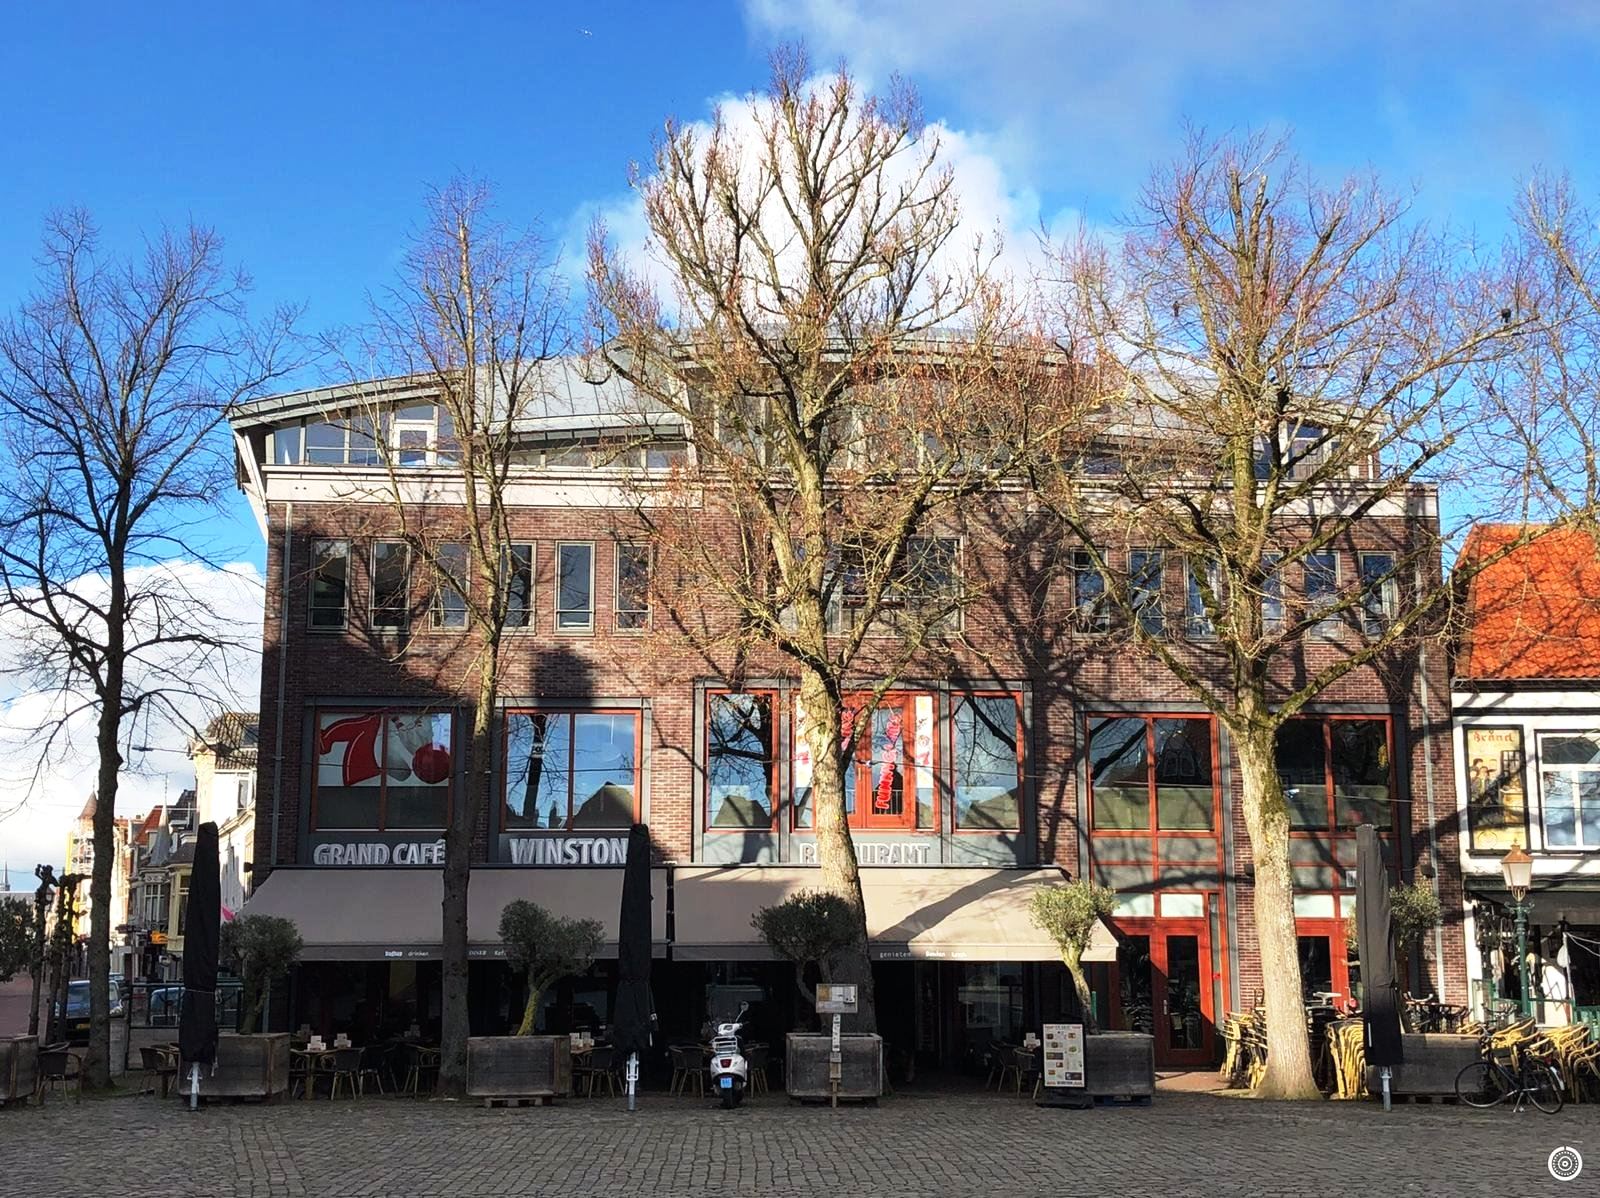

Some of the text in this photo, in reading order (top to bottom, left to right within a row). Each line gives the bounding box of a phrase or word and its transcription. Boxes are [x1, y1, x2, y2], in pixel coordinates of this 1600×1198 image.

[313, 838, 446, 865] GRAND CAFÉ
[509, 837, 629, 865] WINSTON
[799, 842, 931, 865] RURANT
